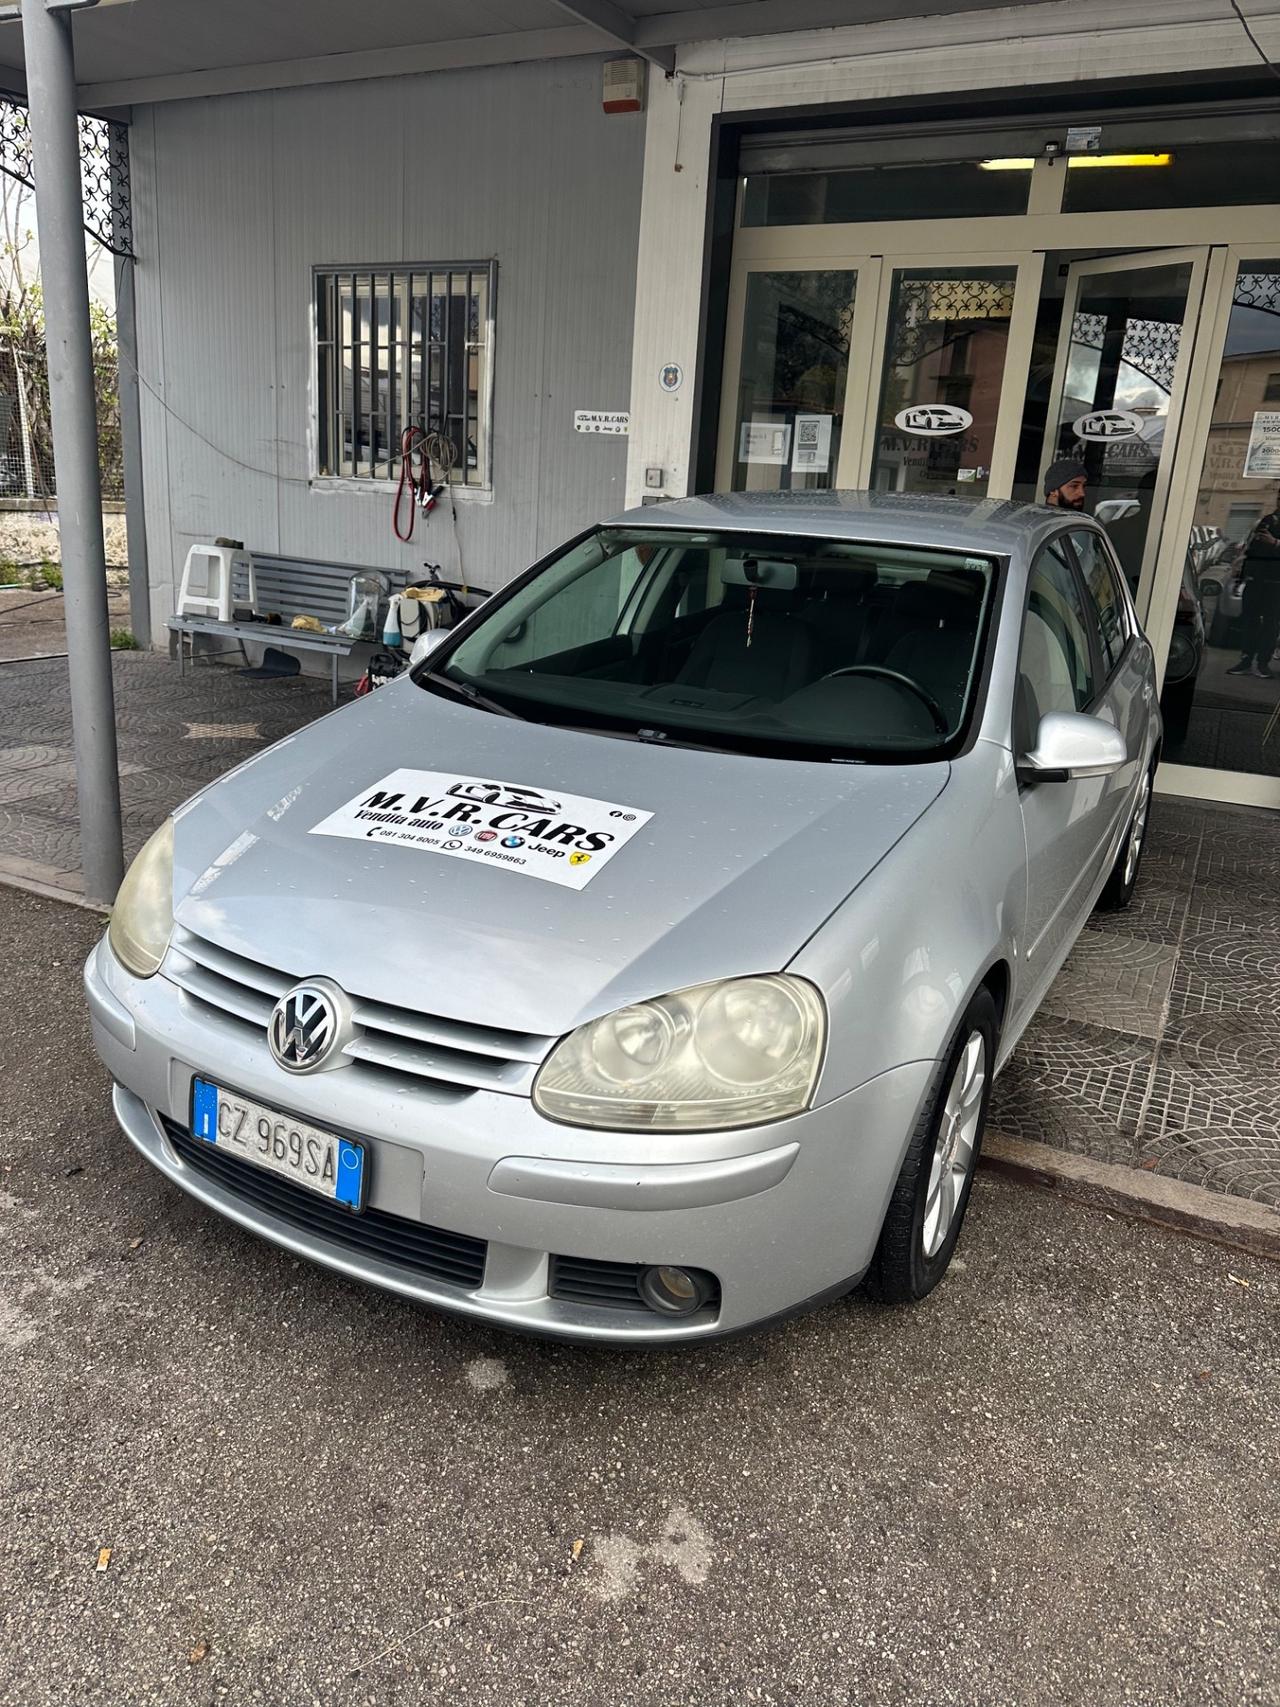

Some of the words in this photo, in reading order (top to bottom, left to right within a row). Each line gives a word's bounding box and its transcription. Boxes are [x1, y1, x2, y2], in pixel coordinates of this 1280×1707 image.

[354, 809, 409, 825] Vendita
[407, 818, 444, 830] auto
[359, 791, 615, 851] M.V.R.CARS
[464, 845, 484, 855] 349
[528, 843, 566, 858] Jeep
